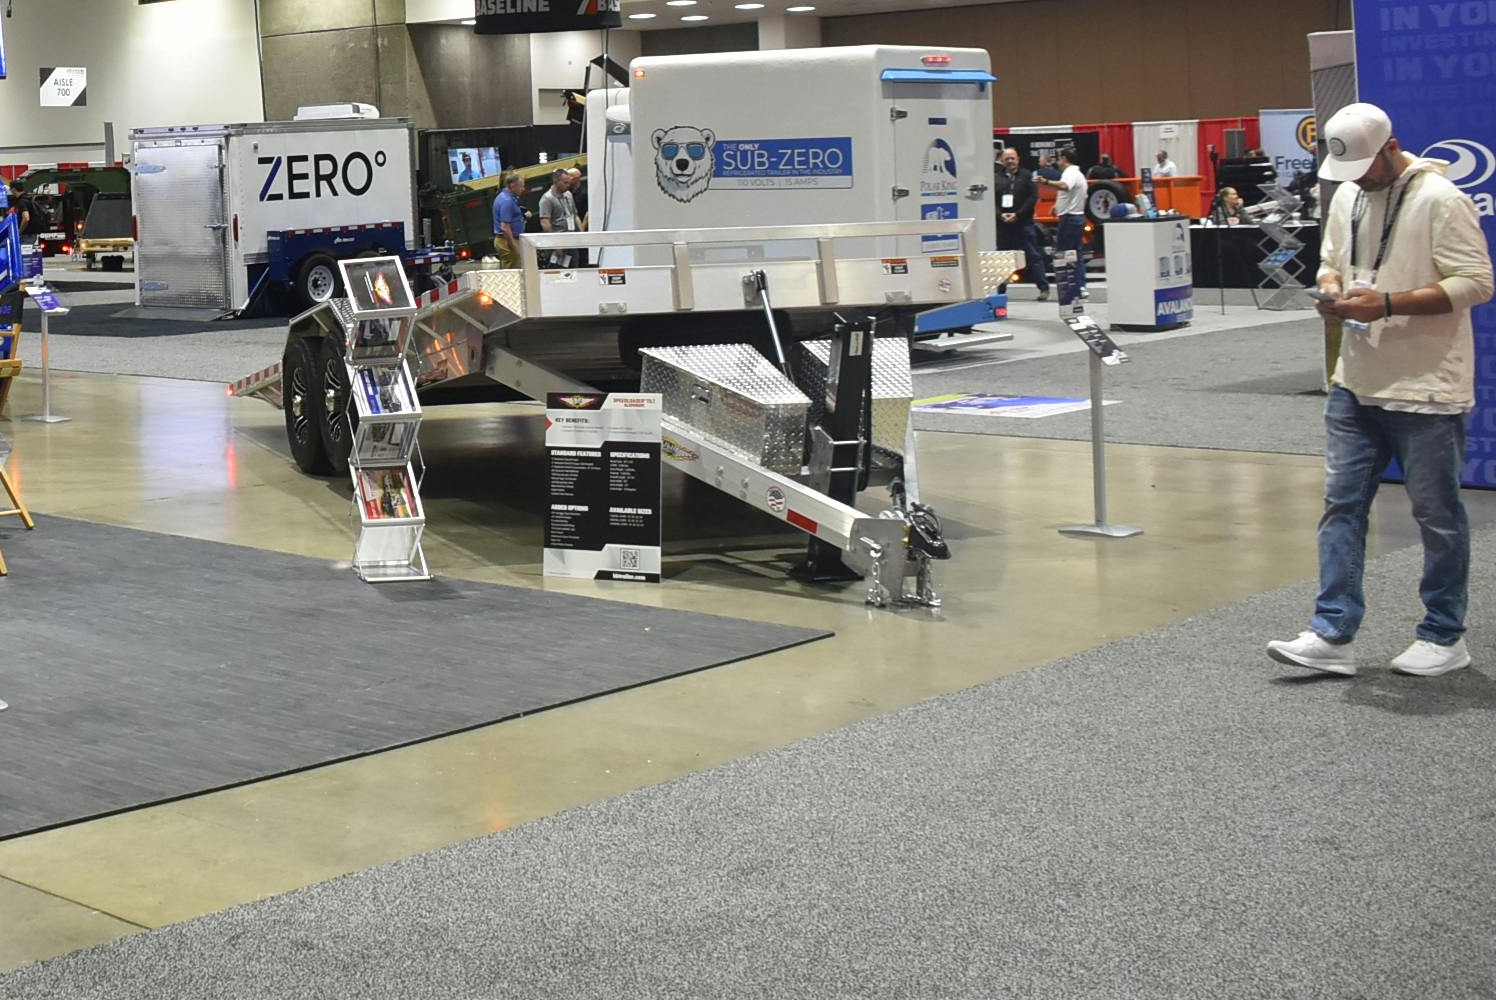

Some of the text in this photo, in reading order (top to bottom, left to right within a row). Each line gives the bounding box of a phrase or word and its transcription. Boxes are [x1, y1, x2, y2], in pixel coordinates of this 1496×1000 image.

[1380, 5, 1420, 31] IN
[53, 78, 73, 87] AISLE
[57, 88, 71, 96] 700
[722, 147, 844, 170] SUB-ZERO
[749, 178, 776, 187] VOLTS
[793, 178, 819, 186] AMPS
